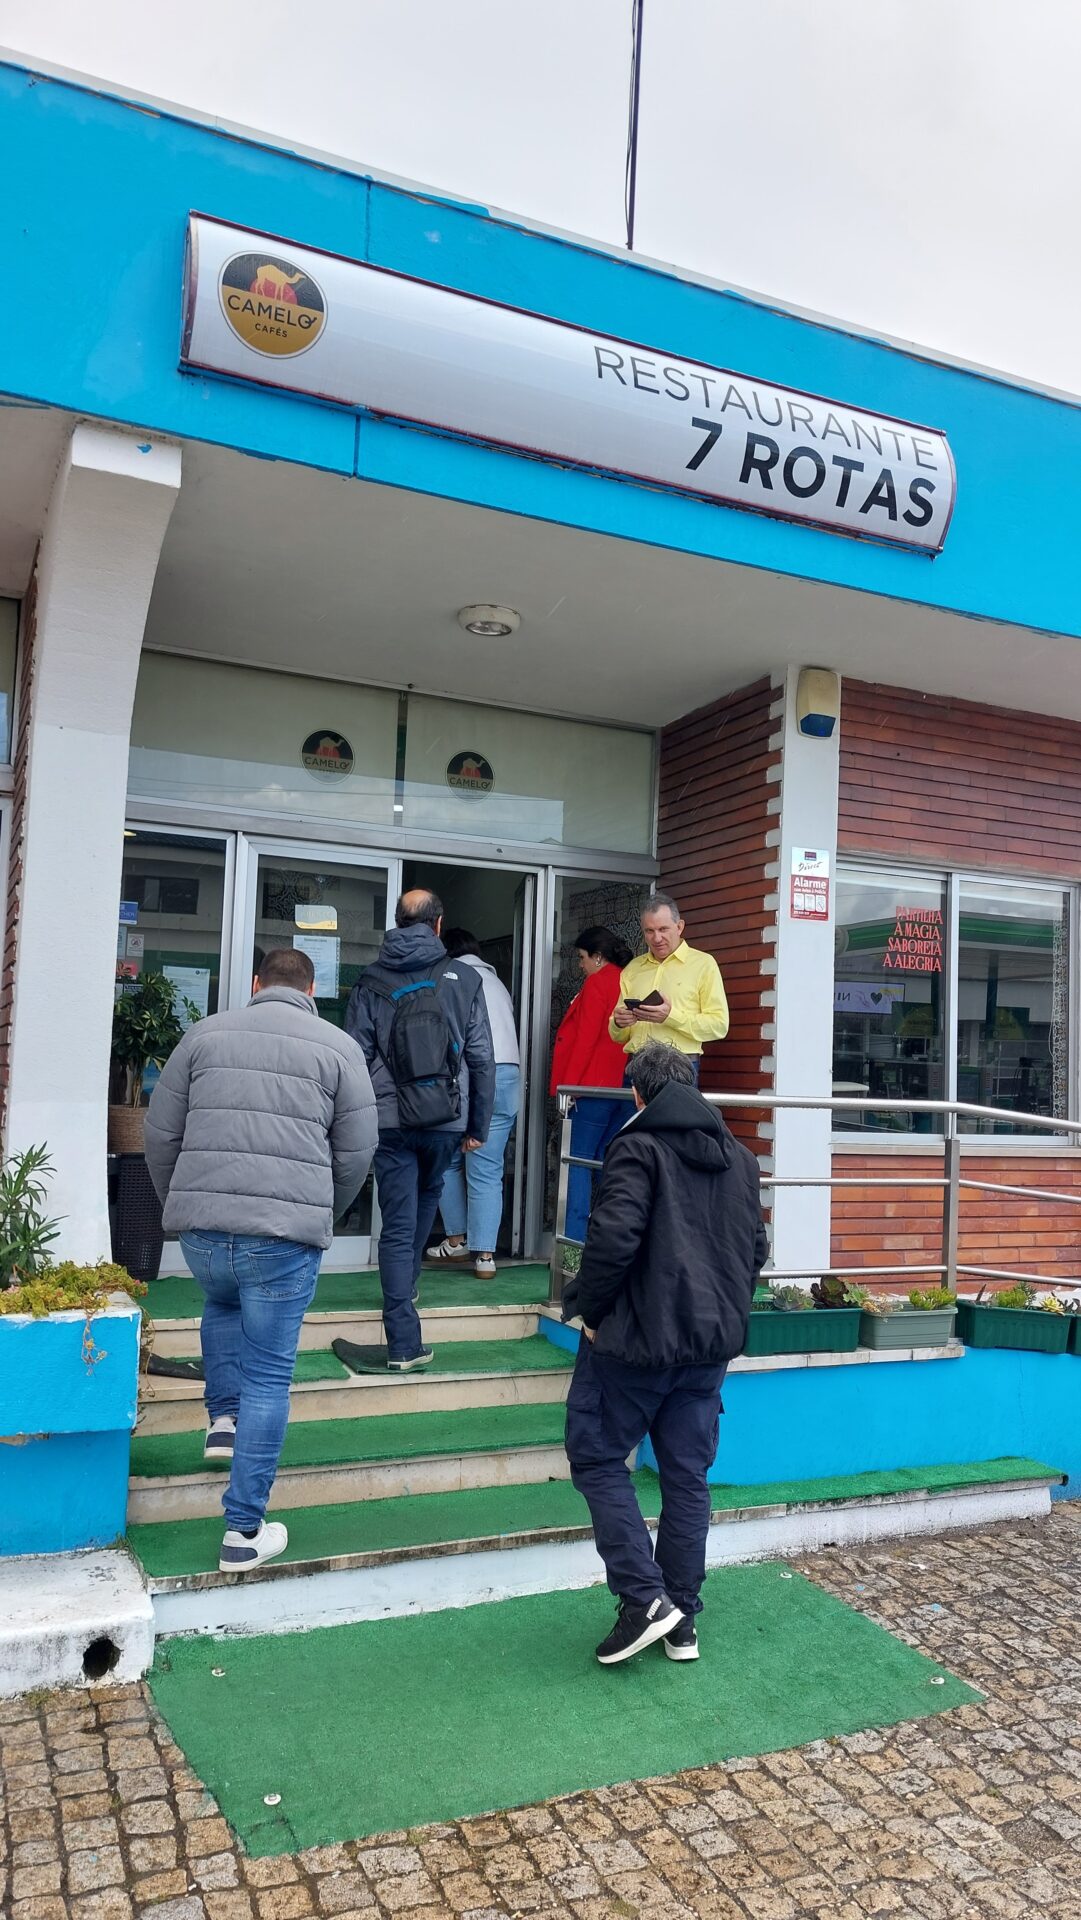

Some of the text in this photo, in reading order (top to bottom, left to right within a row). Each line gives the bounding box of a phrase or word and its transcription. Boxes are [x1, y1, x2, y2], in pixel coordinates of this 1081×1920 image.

[227, 294, 318, 330] CAMELO
[254, 323, 288, 338] CAFÉS
[593, 345, 938, 471] RESTAURANTE
[685, 416, 936, 528] 7 ROTAS
[304, 756, 350, 771] CAMELO
[449, 777, 491, 790] CAMELO
[794, 877, 827, 890] Alarme
[896, 906, 944, 925] PARTILHA
[905, 923, 943, 942] MAGIA,
[888, 937, 942, 956] SABOREIA
[882, 953, 942, 972] A ALEGRIA
